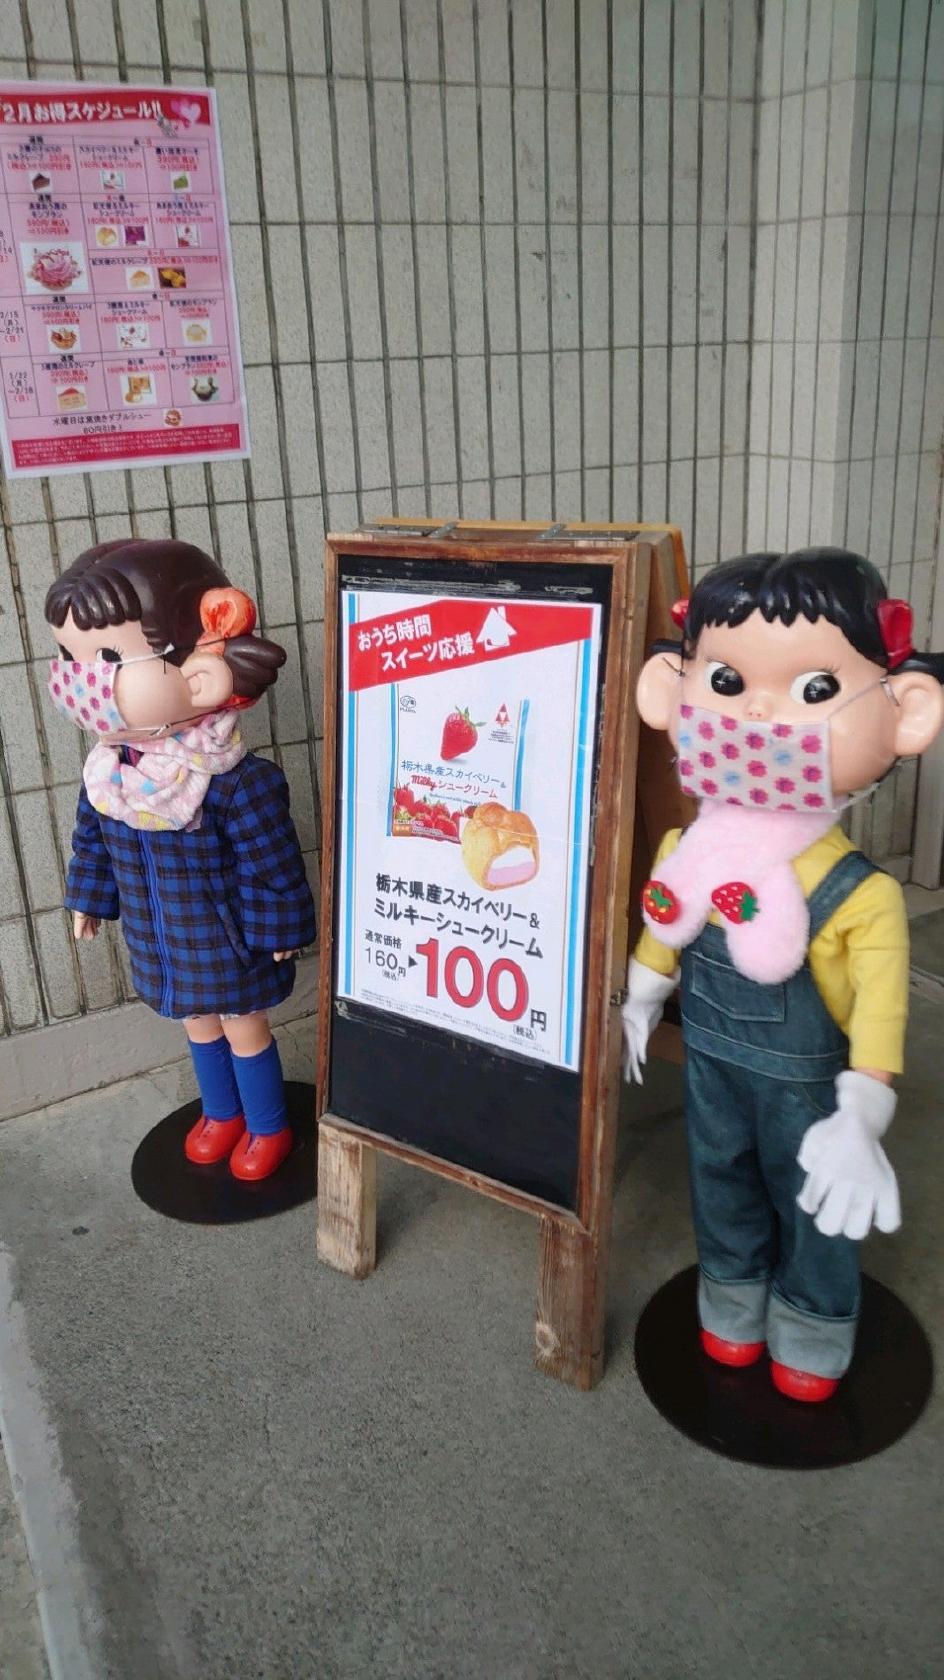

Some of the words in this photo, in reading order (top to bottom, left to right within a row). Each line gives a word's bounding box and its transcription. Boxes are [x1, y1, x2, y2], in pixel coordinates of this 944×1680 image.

[357, 614, 432, 652] おうち時間
[381, 632, 475, 671] スイーツ応援
[376, 873, 541, 930] 栃木県産スカイベリー&
[365, 929, 402, 950] 通常価格
[374, 898, 543, 958] ミルキーシュークリーム
